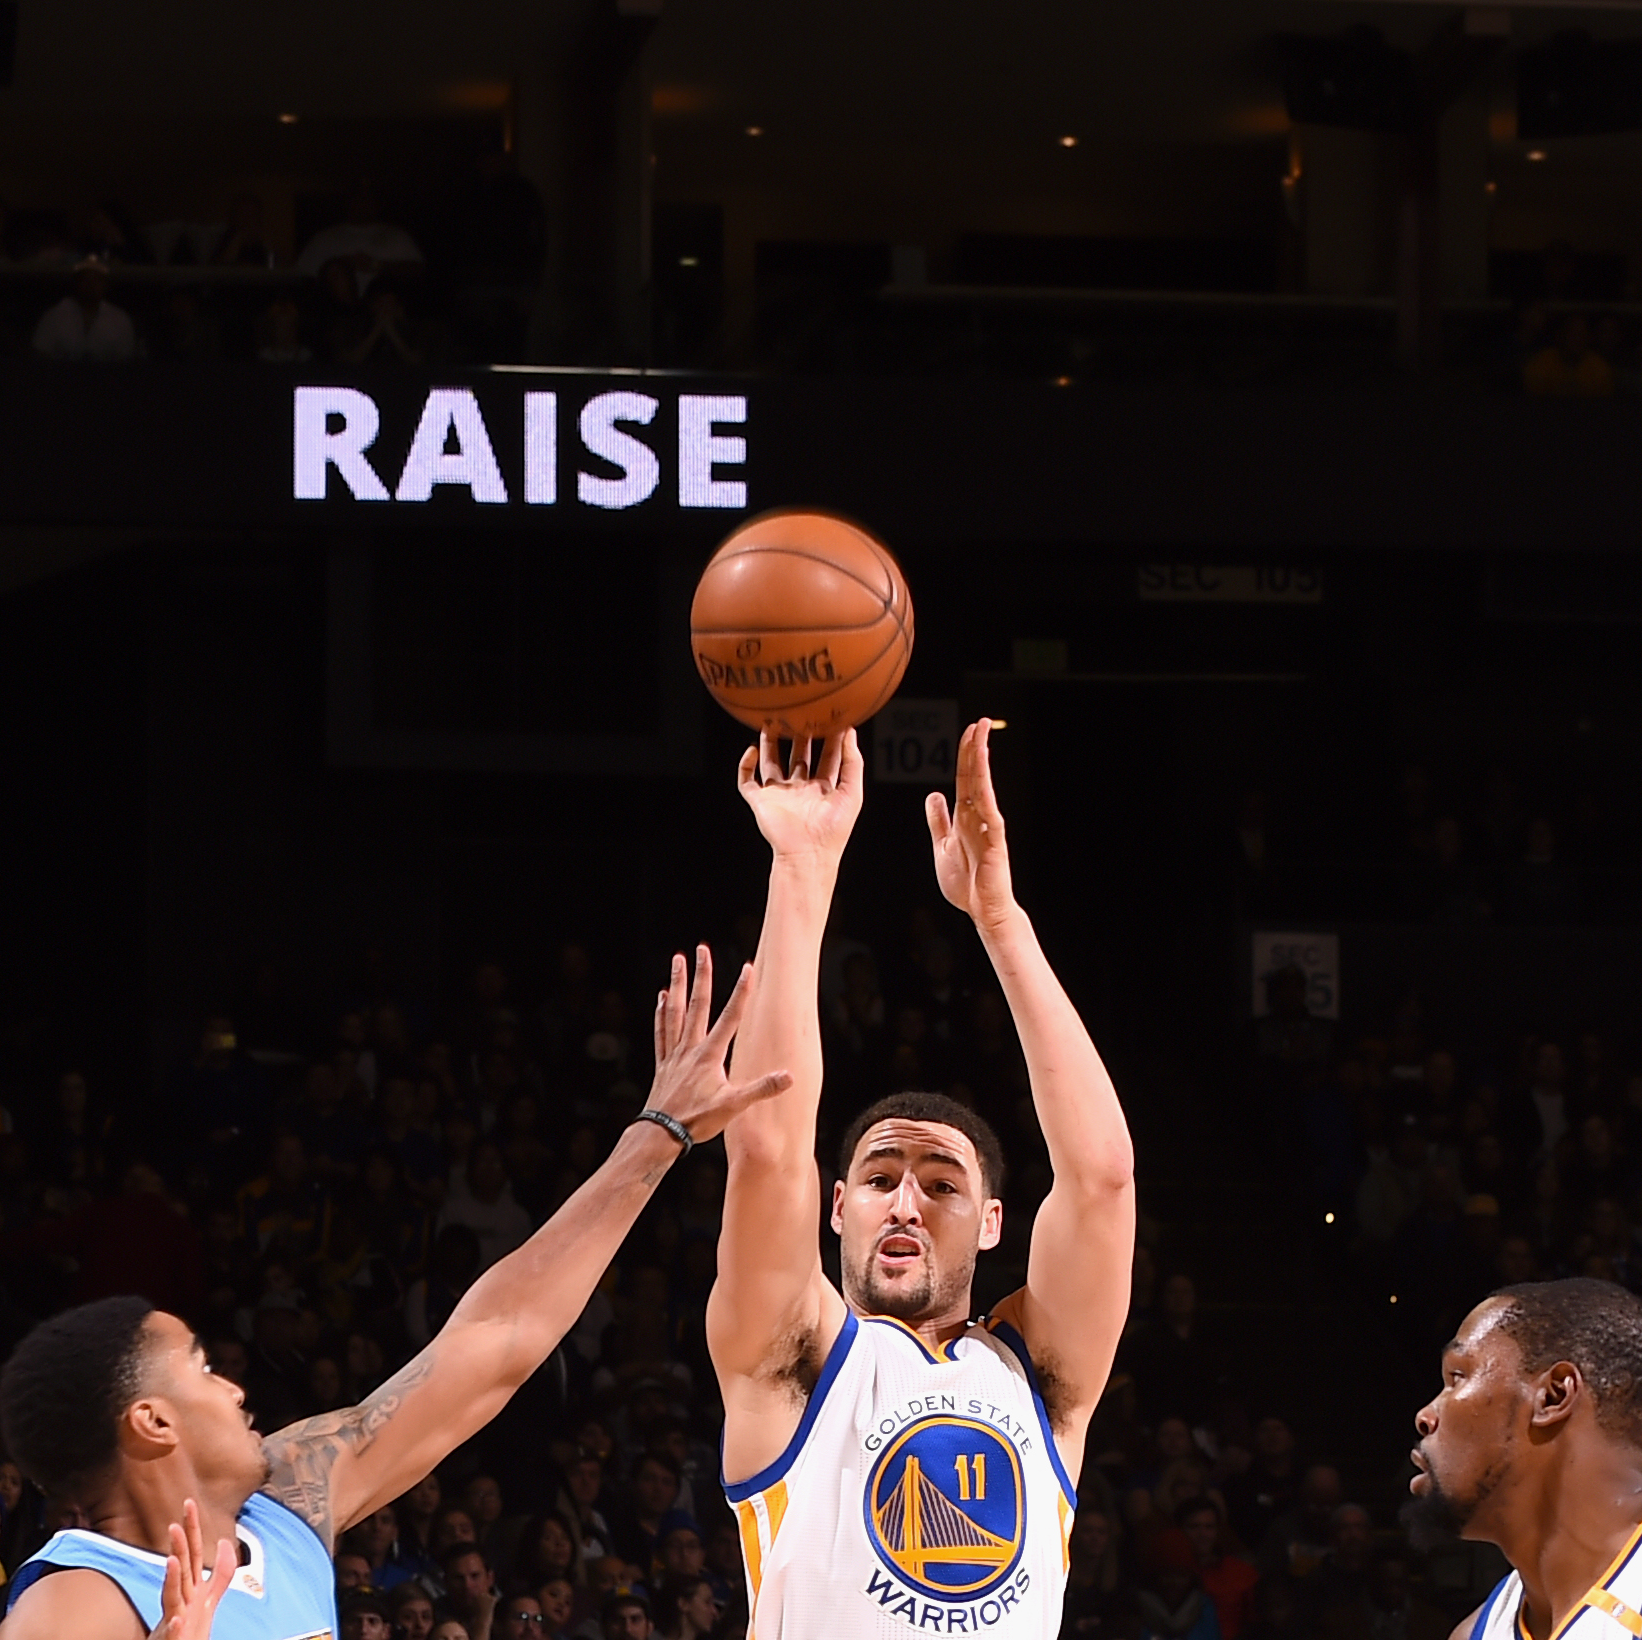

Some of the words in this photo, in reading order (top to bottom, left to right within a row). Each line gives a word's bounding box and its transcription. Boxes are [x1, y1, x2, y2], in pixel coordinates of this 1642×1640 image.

[292, 384, 750, 511] RAISE
[698, 648, 836, 689] SPALDING
[879, 736, 952, 775] 104
[864, 1394, 956, 1452] GOLDEN
[967, 1399, 1033, 1457] STATE
[954, 1453, 987, 1501] 11
[864, 1567, 1032, 1634] WARRIORS
